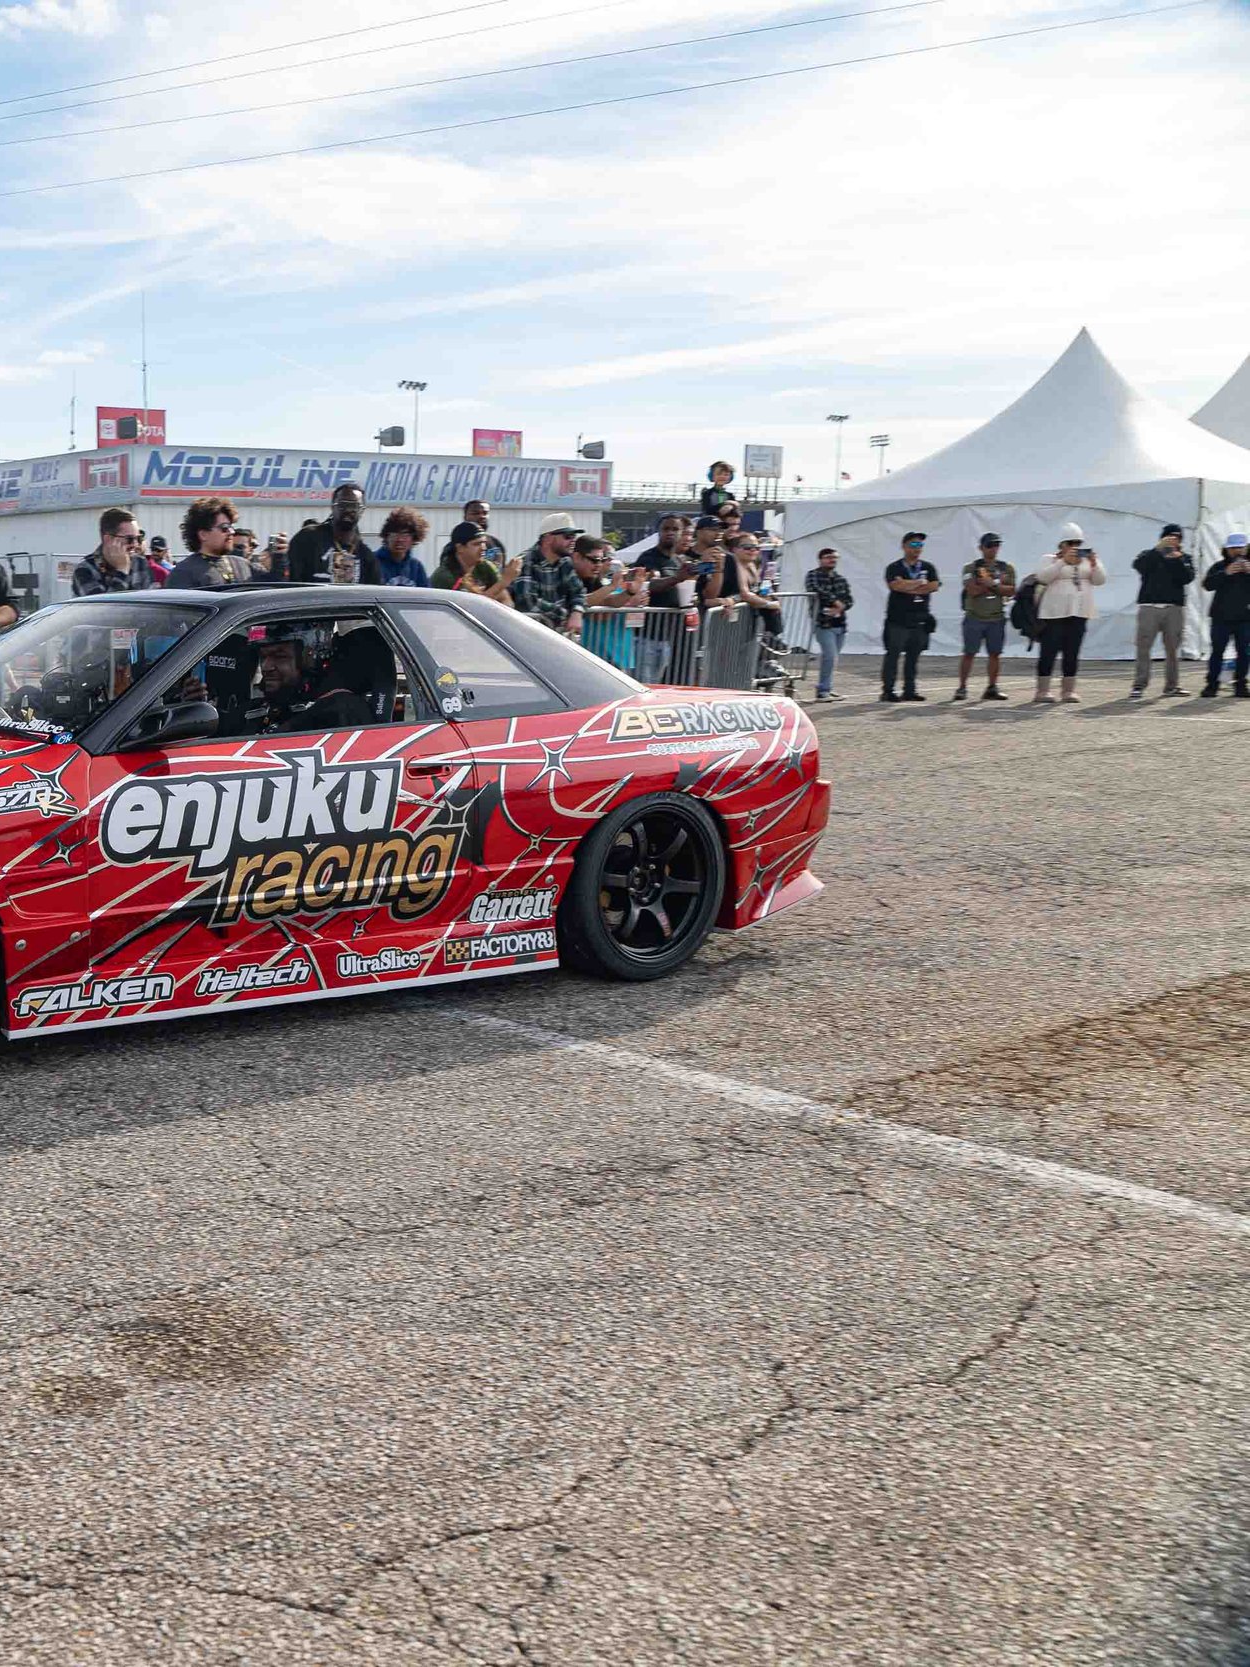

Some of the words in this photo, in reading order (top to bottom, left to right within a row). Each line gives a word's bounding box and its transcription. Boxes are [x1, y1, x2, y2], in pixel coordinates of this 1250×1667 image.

[365, 462, 421, 500] MEDIA
[423, 465, 438, 500] &
[439, 465, 495, 501] EVENT
[495, 466, 555, 503] CENTER
[442, 697, 462, 713] 69
[108, 757, 394, 868] enjuku
[222, 833, 456, 918] racing
[469, 891, 553, 922] Garrett
[199, 960, 309, 995] Haltech
[339, 950, 420, 976] UltraSlice
[17, 976, 172, 1016] FALKEN
